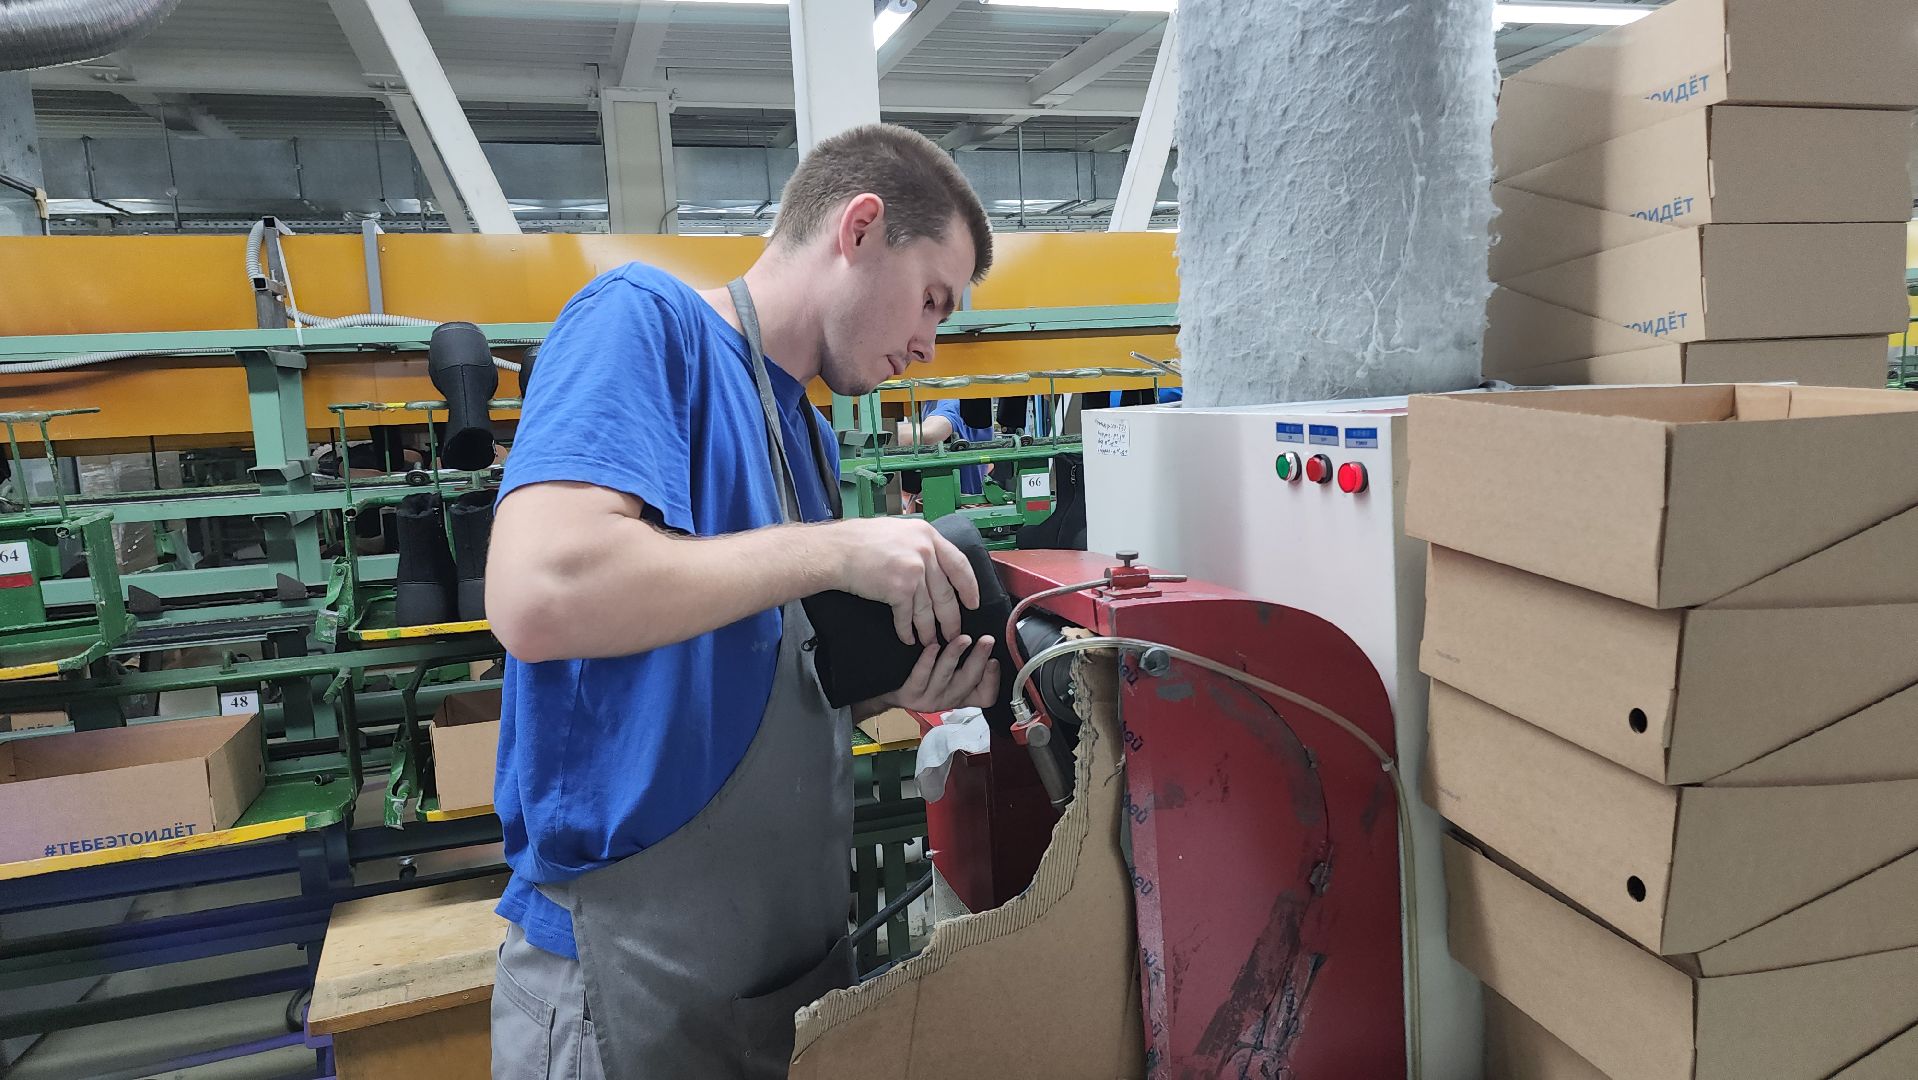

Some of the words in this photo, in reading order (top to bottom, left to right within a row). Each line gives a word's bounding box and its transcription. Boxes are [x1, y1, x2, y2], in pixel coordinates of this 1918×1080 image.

[1028, 477, 1042, 487] 66
[0, 549, 19, 563] 64
[231, 695, 248, 708] 48
[44, 822, 197, 857] #ТЕБЕЭТОИДЁТ
